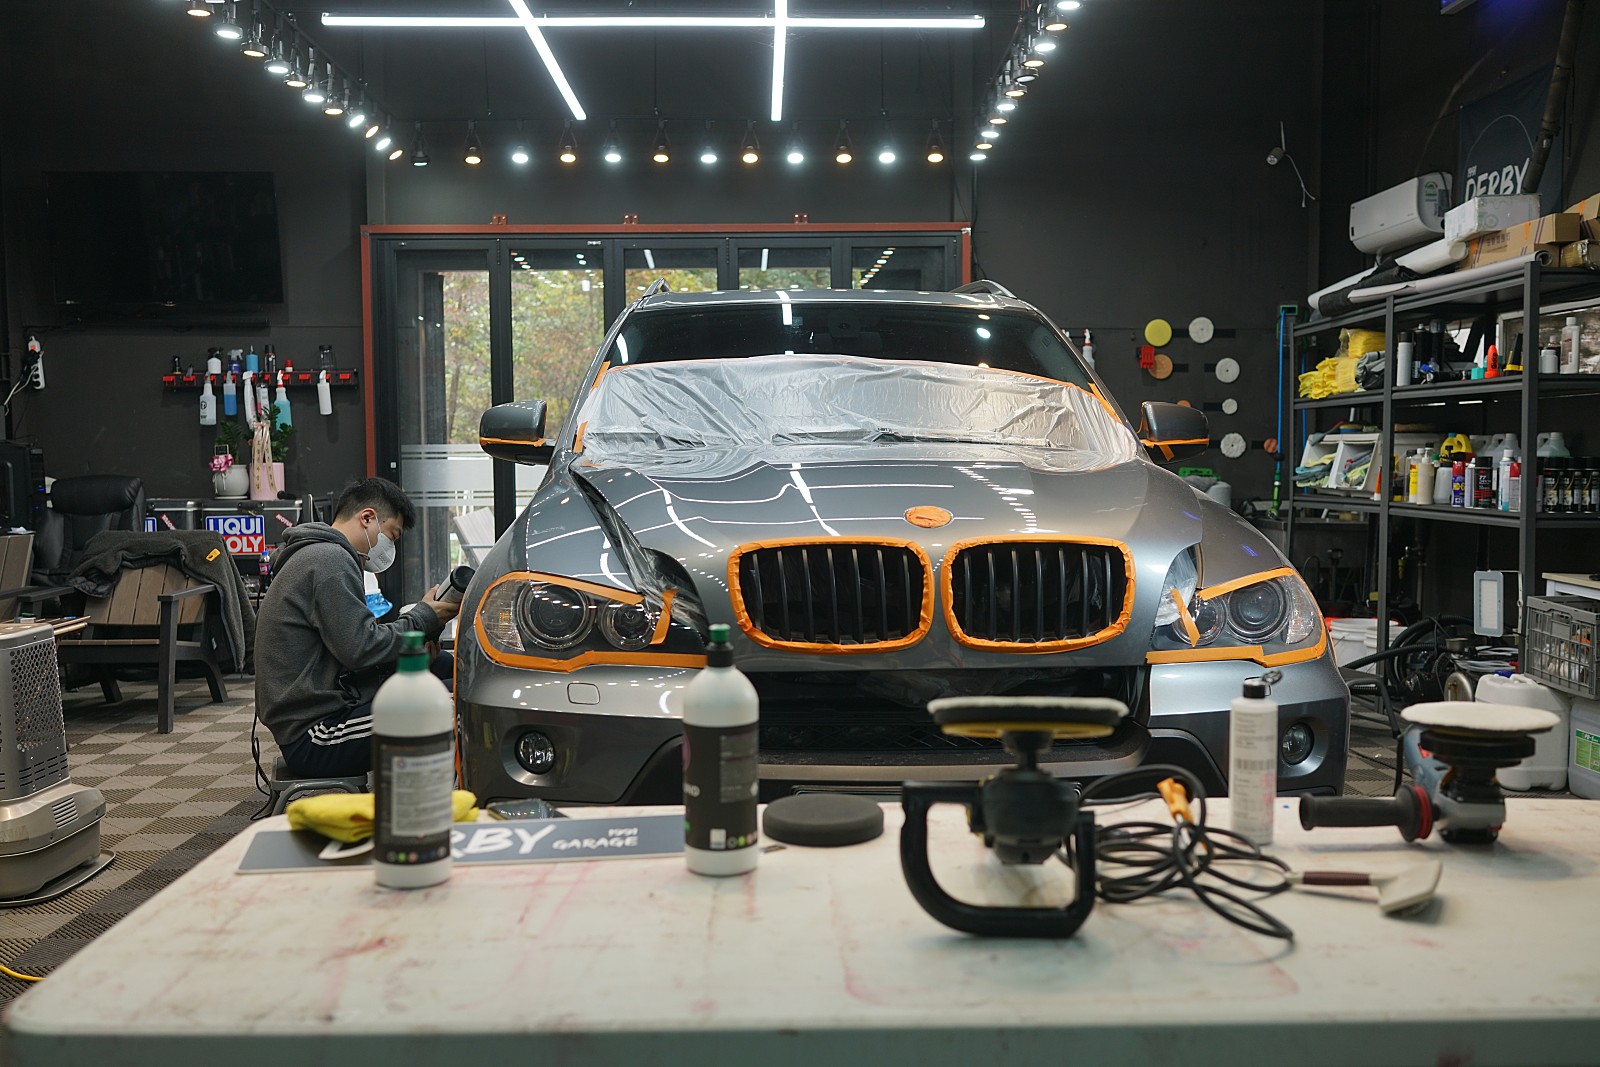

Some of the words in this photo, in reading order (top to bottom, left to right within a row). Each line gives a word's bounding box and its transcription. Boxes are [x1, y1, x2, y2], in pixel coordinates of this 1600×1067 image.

[209, 518, 260, 535] LIQUI
[224, 535, 262, 553] OLY
[552, 836, 638, 850] GARAGE
